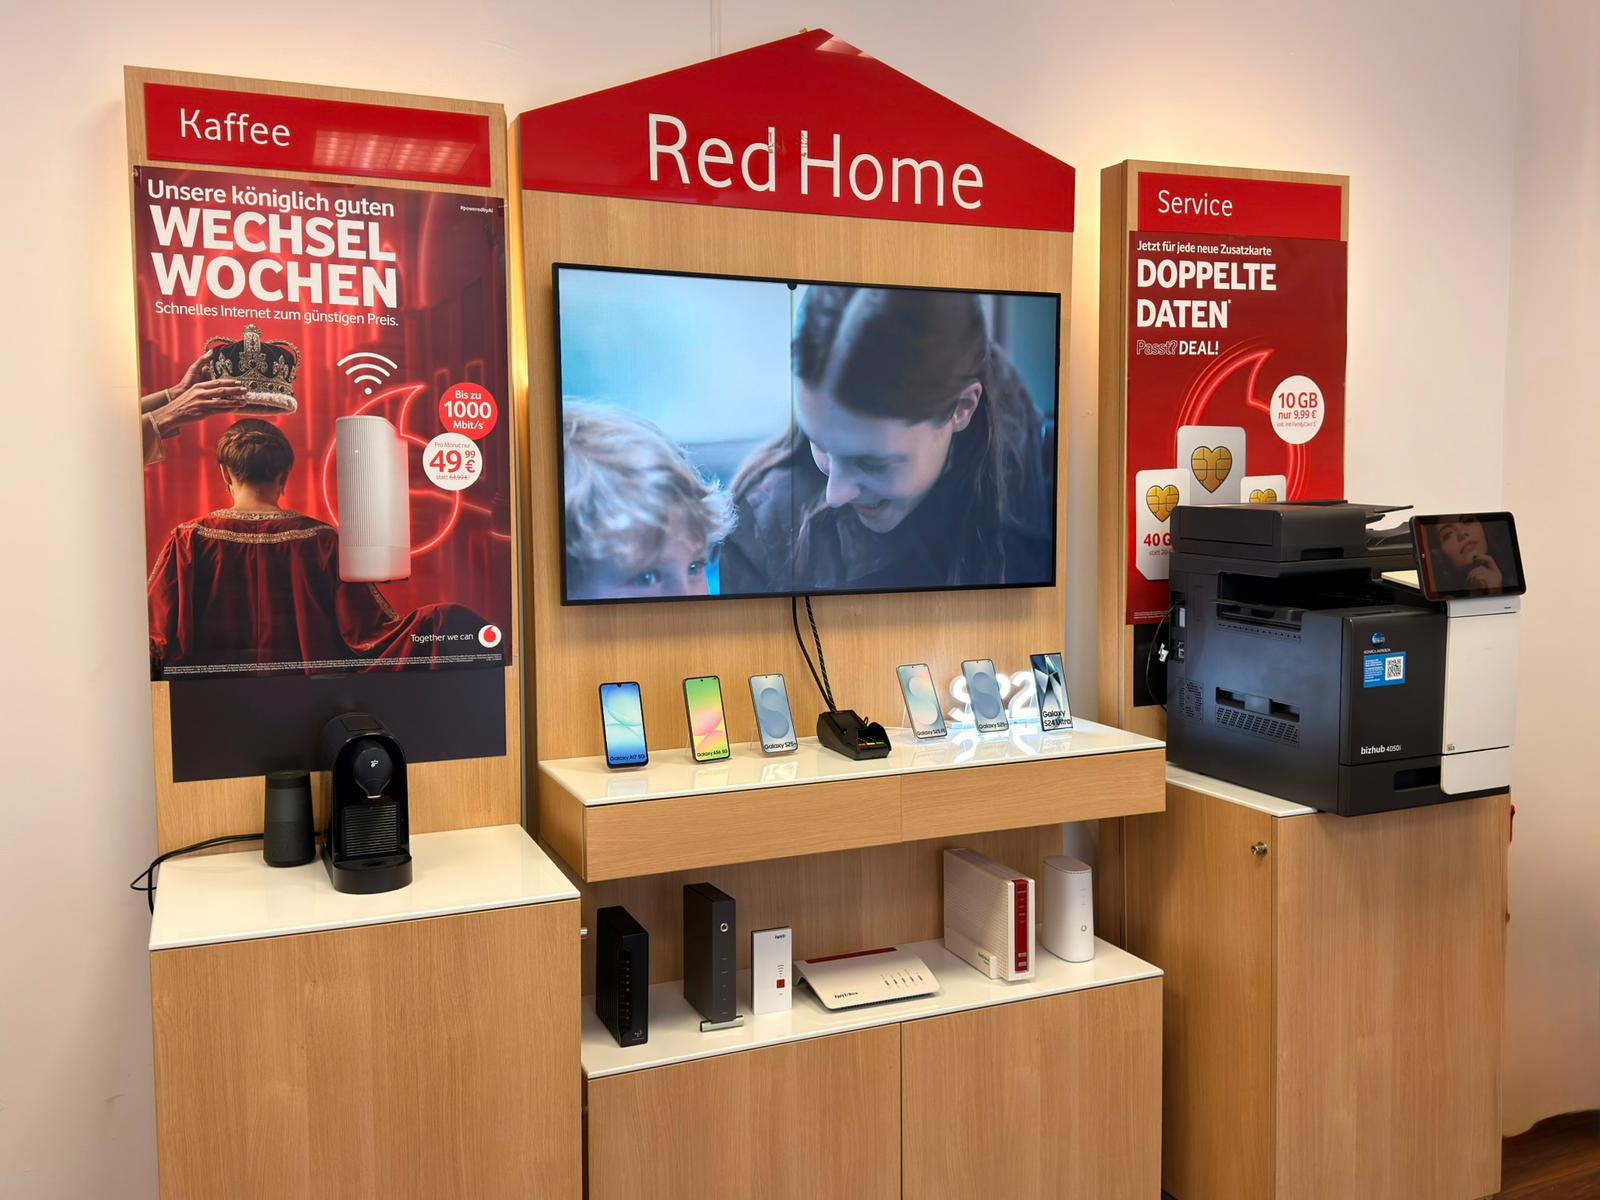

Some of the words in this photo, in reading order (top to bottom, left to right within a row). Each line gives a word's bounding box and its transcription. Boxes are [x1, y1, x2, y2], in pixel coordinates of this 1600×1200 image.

[179, 107, 291, 147] Kaffee
[648, 112, 776, 193] Red
[800, 129, 984, 210] Home
[147, 178, 227, 204] Unsere
[231, 185, 330, 214] königlich
[334, 198, 395, 218] guten
[1157, 189, 1233, 217] Service
[149, 204, 397, 262] WECHSEL
[1137, 240, 1161, 252] Jetzt
[1162, 241, 1176, 252] für
[1176, 242, 1196, 254] jede
[1197, 244, 1219, 254] neue
[1220, 243, 1273, 256] Zusatzkarte
[151, 252, 398, 309] WOCHEN
[1137, 258, 1277, 291] DOPPELTE
[155, 301, 219, 317] Schnelles
[221, 304, 272, 319] Internet
[273, 310, 301, 321] zum
[304, 309, 365, 326] günstigen
[367, 312, 399, 327] Preis.
[1136, 339, 1178, 356] Passt?
[1179, 340, 1219, 356] DEAL!
[455, 390, 469, 400] Bis
[1278, 392, 1296, 409] 10
[1298, 392, 1318, 409] GB
[444, 400, 492, 419] 1000
[1278, 411, 1292, 420] nur
[1294, 410, 1310, 419] 9,99
[1312, 410, 1317, 418] €
[453, 420, 484, 430] Mbit/s
[429, 449, 463, 473] 49
[464, 450, 476, 459] 99
[464, 459, 476, 473] €
[1143, 532, 1161, 547] 40
[1162, 532, 1172, 547] G
[411, 634, 445, 643] Together
[460, 633, 474, 641] can
[1043, 710, 1066, 718] Galaxy
[764, 742, 784, 750] Galaxy
[1360, 745, 1386, 755] bizhub
[1386, 744, 1402, 752] 4050i
